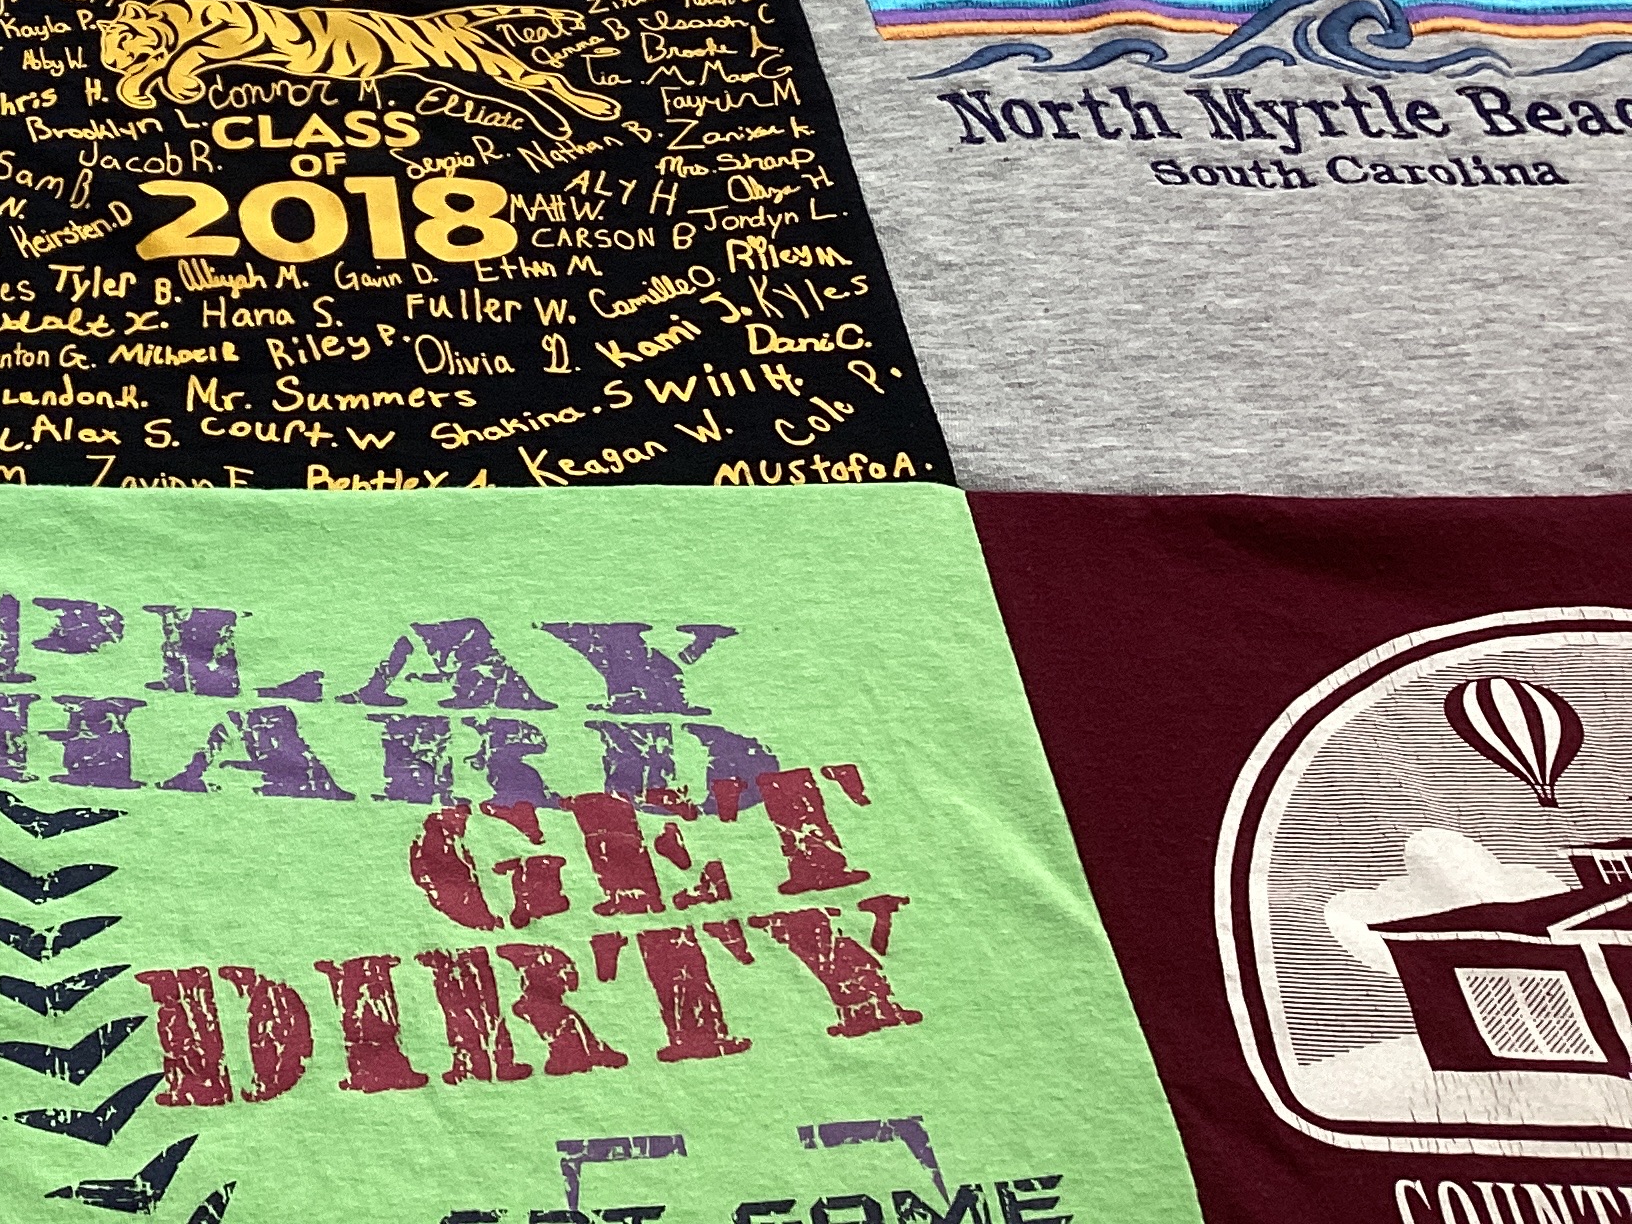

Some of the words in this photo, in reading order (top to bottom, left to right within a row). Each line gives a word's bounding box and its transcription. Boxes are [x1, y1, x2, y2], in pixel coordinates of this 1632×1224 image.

[0, 15, 71, 41] Kayla
[211, 110, 421, 150] CLASS
[936, 83, 1182, 146] North
[1186, 82, 1450, 154] Myrtle
[79, 141, 183, 176] Jacob
[290, 151, 347, 177] OF
[1151, 156, 1318, 192] South
[1328, 154, 1568, 189] Carolina
[135, 176, 519, 264] 2018
[531, 226, 656, 251] CARSON
[48, 264, 137, 303] Tyler
[406, 287, 522, 323] Fuller
[266, 334, 371, 371] Riley
[414, 333, 516, 376] Olivia
[186, 374, 253, 412] Mr.
[272, 375, 478, 412] Summers
[409, 764, 871, 932] GET
[135, 895, 925, 1108] DIRTY
